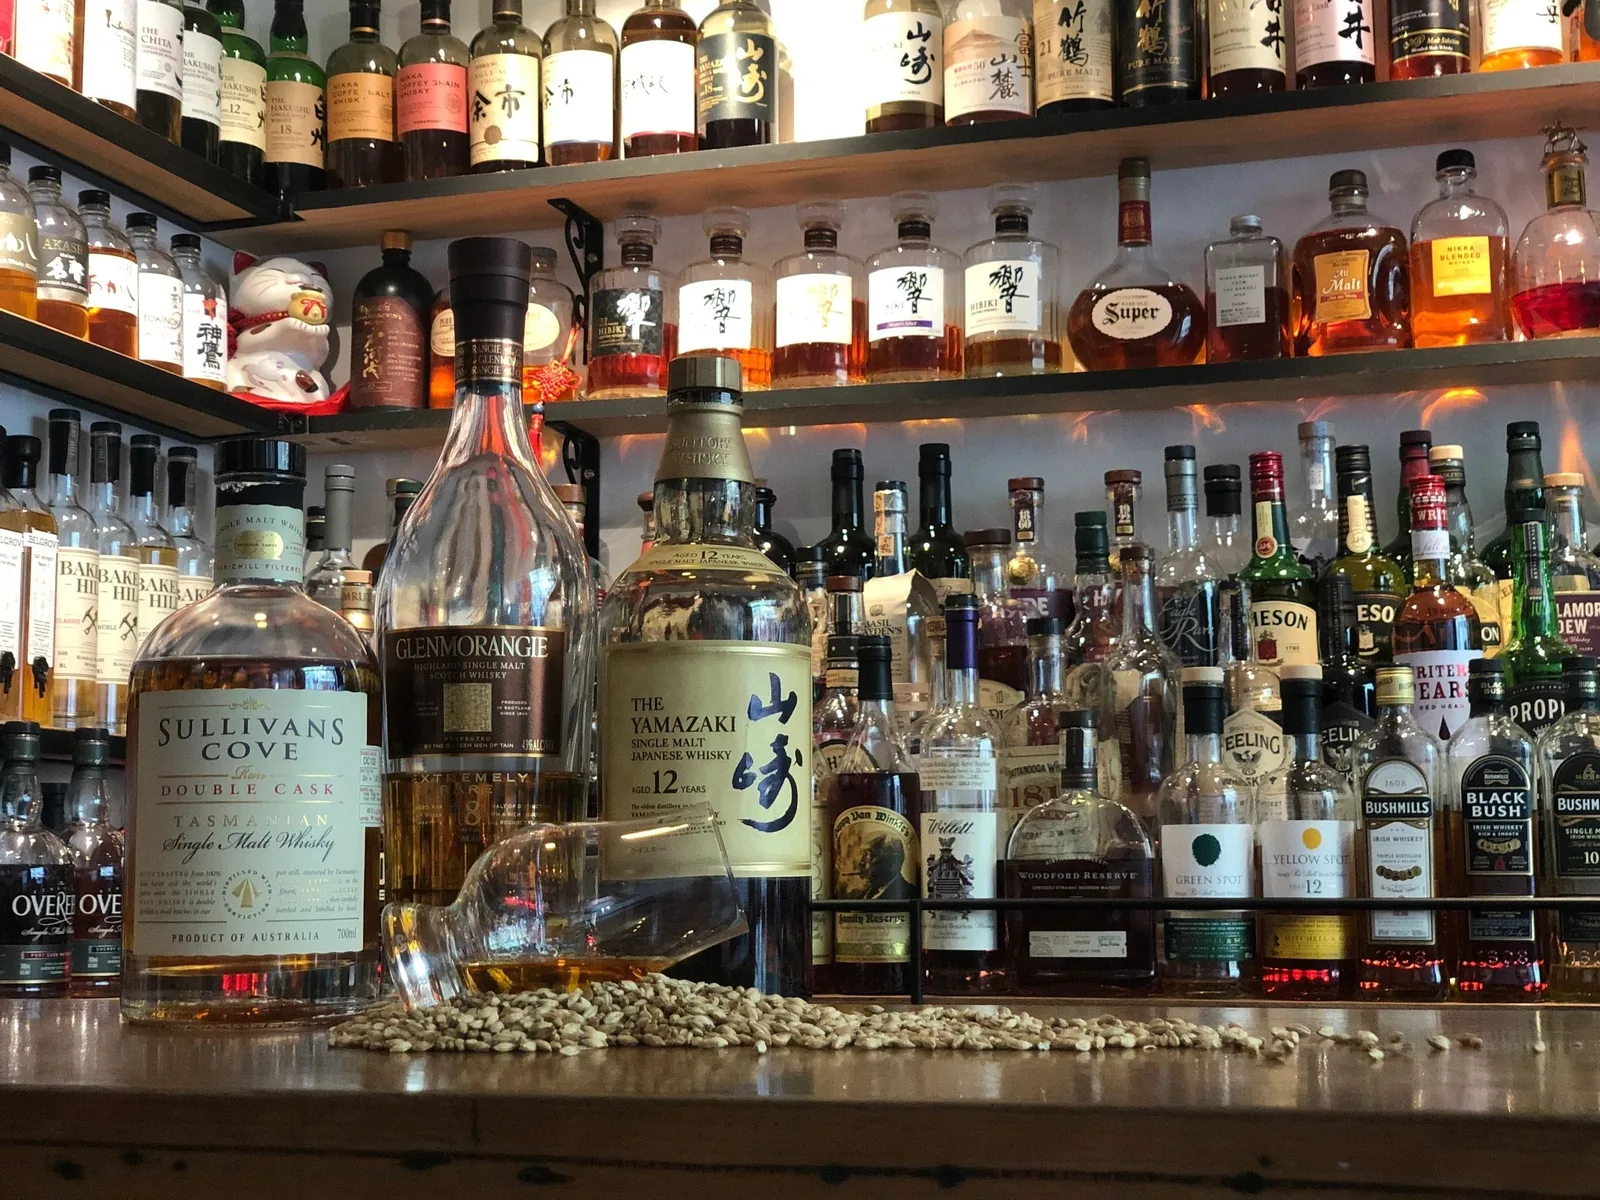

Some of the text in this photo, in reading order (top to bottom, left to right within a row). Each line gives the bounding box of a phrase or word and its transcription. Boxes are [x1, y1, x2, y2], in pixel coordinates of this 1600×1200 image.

[142, 26, 158, 35] THE
[141, 35, 172, 49] CHITA
[1039, 40, 1052, 57] 21
[900, 20, 936, 85] 山崎
[1127, 56, 1182, 71] PURE MALT
[1048, 68, 1101, 80] PURE MALT
[333, 81, 359, 90] NIKKA
[401, 80, 428, 91] COFFEY
[333, 89, 366, 98] COFFE
[229, 103, 241, 114] 12
[279, 125, 292, 135] 18
[1446, 245, 1476, 253] NIKKA
[1440, 252, 1481, 261] BLENDED
[1334, 269, 1349, 279] All
[896, 270, 934, 315] 響
[989, 264, 1031, 314] 響
[1322, 279, 1362, 295] Malt
[970, 298, 998, 312] HIBIKI
[1102, 300, 1161, 327] Super
[598, 325, 627, 337] HIBIKI
[246, 516, 277, 525] MALT
[699, 558, 740, 566] JAPANESE
[701, 550, 719, 560] 12
[720, 552, 747, 561] YEARS
[1357, 604, 1396, 624] ESO
[396, 635, 549, 660] GLENMORANGIE
[414, 661, 526, 671] HIGHLAND SINGLE MALT
[429, 671, 507, 680] SCOTCH WHISKY
[631, 696, 664, 711] THE
[1419, 703, 1465, 711] RED HEAD
[631, 715, 736, 734] YAMAZAKI
[157, 716, 344, 747] SULLIVANS
[631, 737, 705, 748] SINGLE MALT
[200, 741, 298, 761] COVE
[631, 750, 732, 761] JAPANESE WHISKY
[731, 671, 804, 833] 山崎
[413, 772, 529, 784] EXTREMELY
[631, 769, 706, 794] AGED 12 YEARS
[1484, 772, 1509, 781] BUSHMILLS
[160, 783, 334, 797] DOUBLE CASK
[1384, 779, 1407, 788] 1608
[1466, 791, 1526, 805] BLACK
[1557, 797, 1600, 811] BUSHM
[1365, 800, 1430, 815] BUSHMILLS
[1471, 805, 1522, 818] BUSH
[173, 814, 329, 829] TASMANIAN
[851, 810, 872, 822] Van
[928, 817, 975, 836] Willett
[1565, 827, 1594, 835] SINGLE
[162, 824, 335, 865] Single Malt Whisky
[1373, 835, 1424, 843] IRISH WHISKEY
[1272, 854, 1350, 866] YELLOW SPOT
[1583, 851, 1599, 865] 10
[1018, 870, 1137, 881] WOODFORD RESERVE
[1175, 874, 1243, 886] GREEN SPOT
[1304, 879, 1322, 894] 12
[21, 925, 49, 942] Single
[88, 924, 113, 939] Single
[171, 931, 321, 943] PRODUCT OF AUSTRALIA
[337, 926, 358, 940] 700ml
